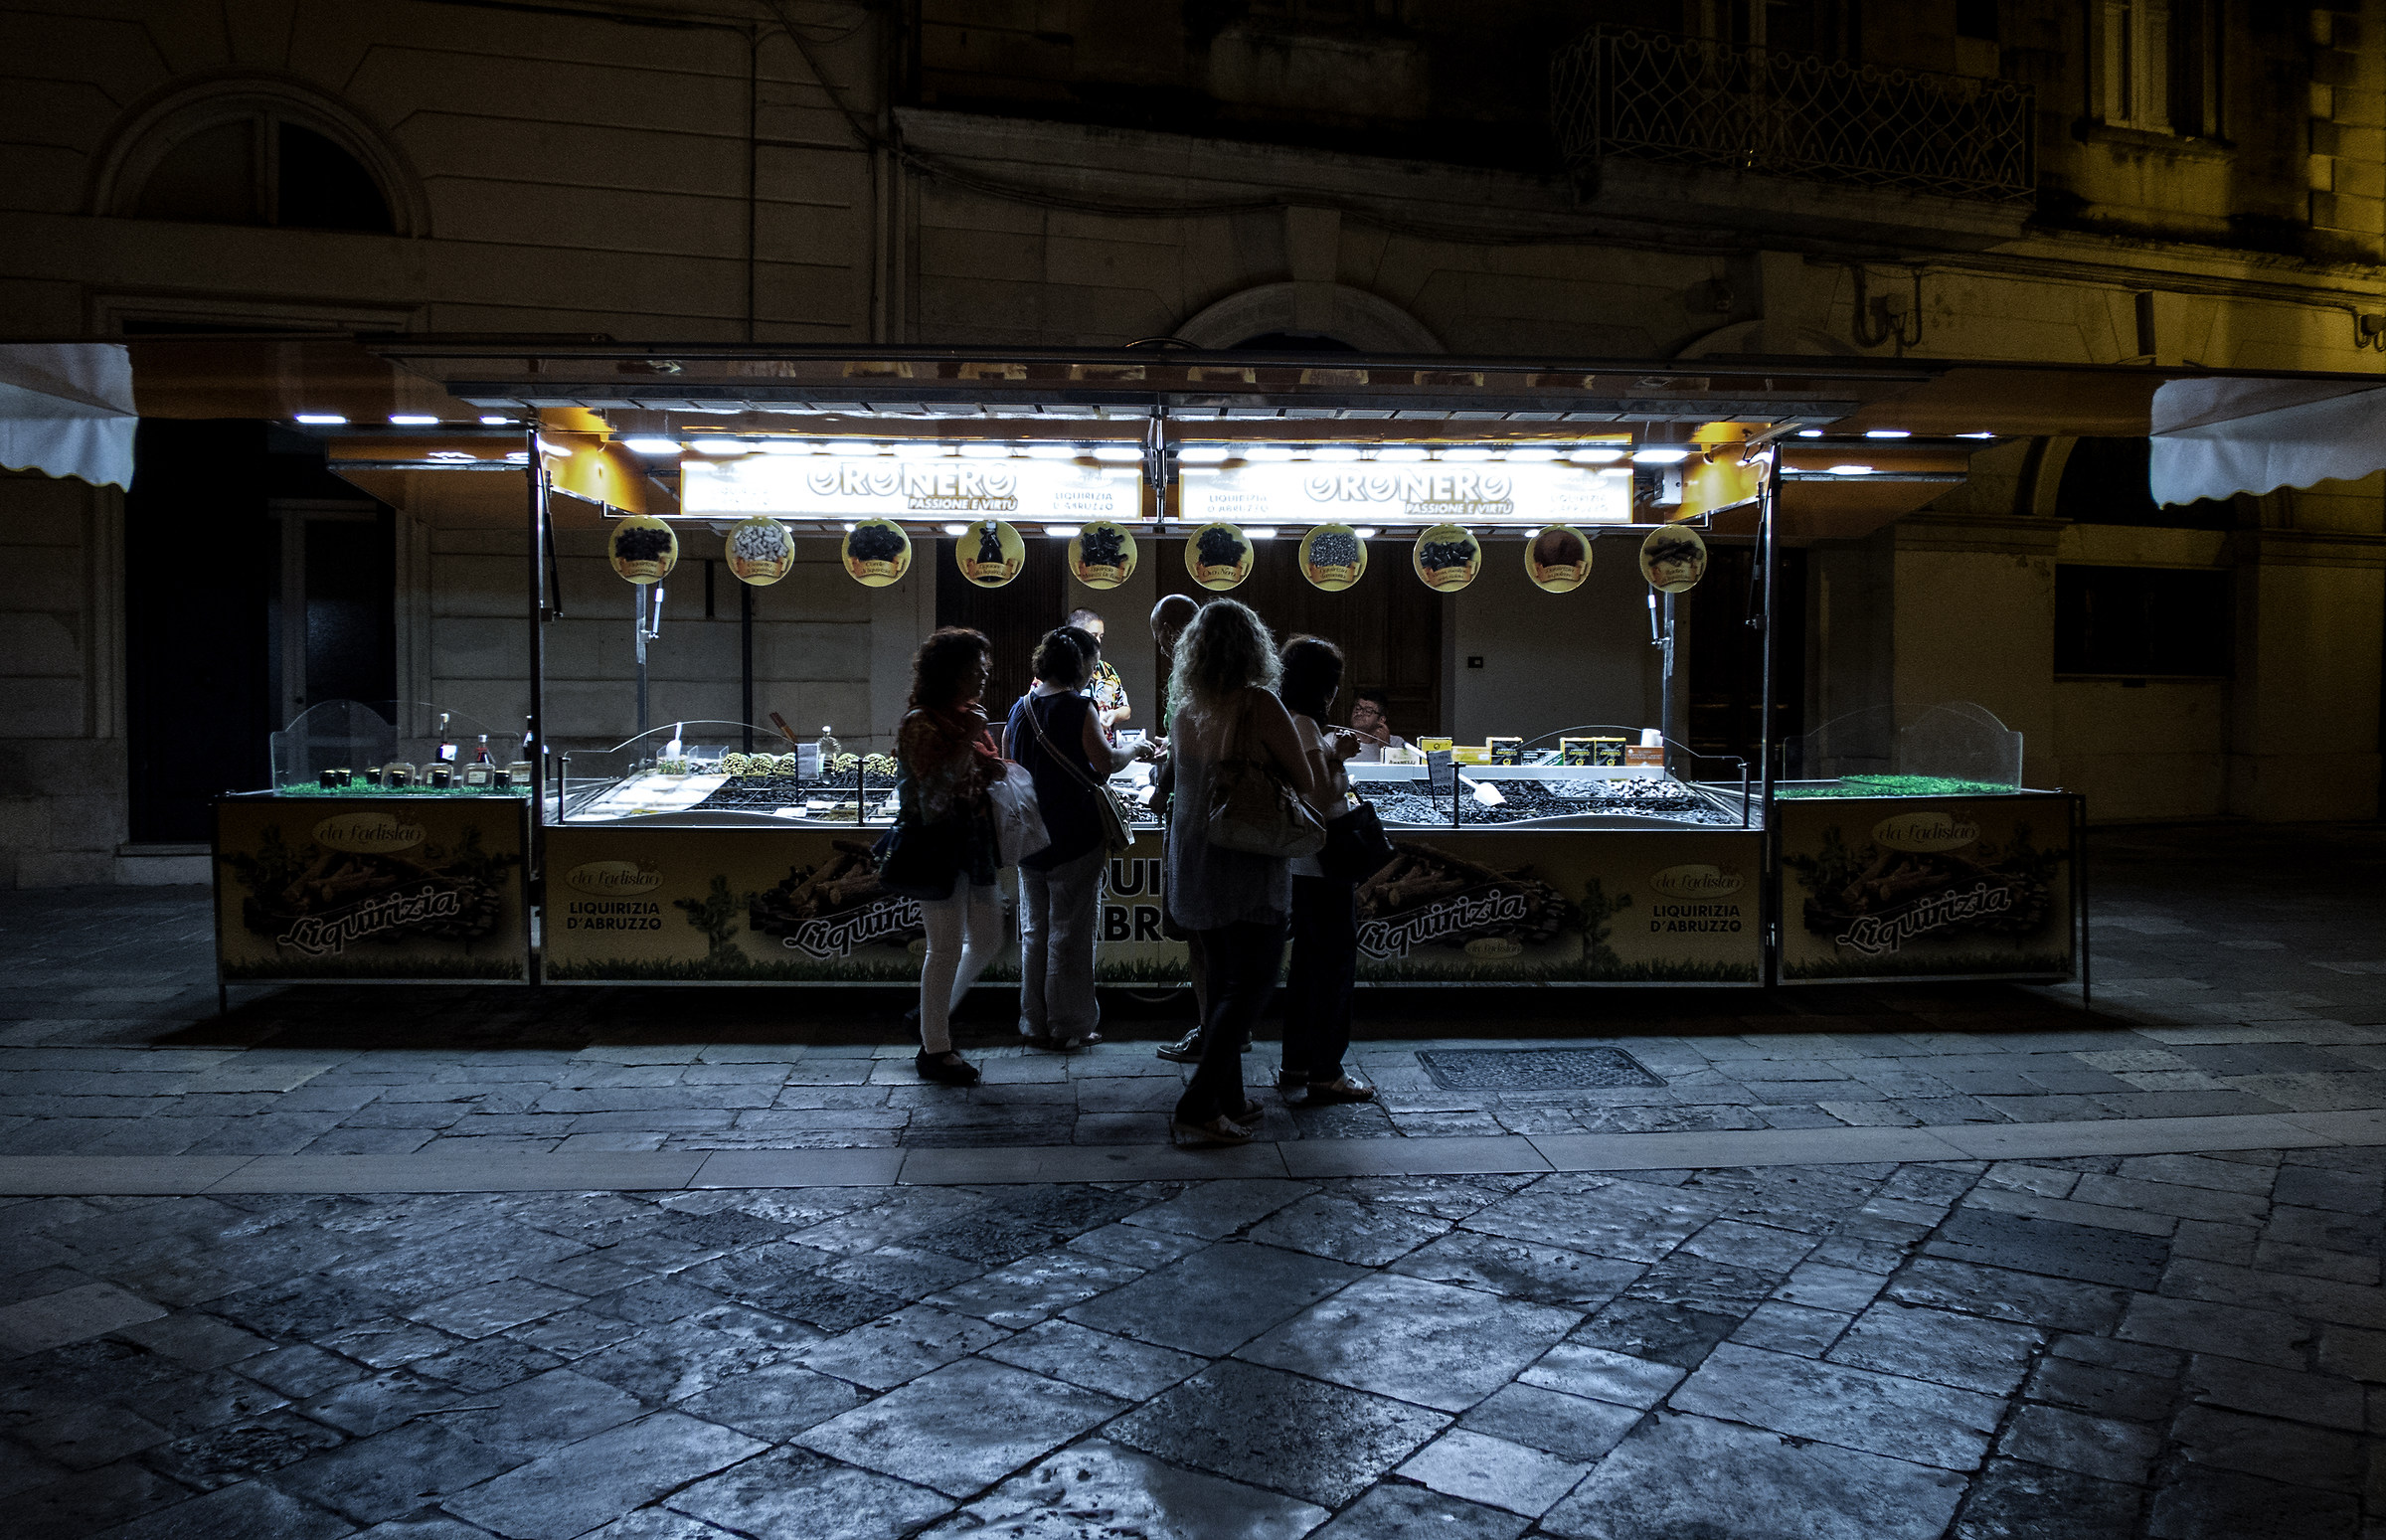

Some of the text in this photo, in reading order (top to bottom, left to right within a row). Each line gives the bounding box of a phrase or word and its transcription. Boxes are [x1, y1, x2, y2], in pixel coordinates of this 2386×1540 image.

[907, 497, 968, 511] PASSIONE
[971, 497, 979, 511] E
[1404, 502, 1464, 515] PASSIONE
[1467, 502, 1475, 515] E
[320, 824, 342, 840] da
[1879, 824, 1901, 840] da
[572, 869, 594, 884] da
[1656, 874, 1676, 889] da
[569, 901, 661, 917] LIQUIRIZIA
[1652, 904, 1741, 919] LIQUIRIZIA
[276, 885, 464, 955] Liquirizia
[567, 915, 662, 931] D'ABRUZZO
[1356, 888, 1529, 962] Liquirizia
[1650, 919, 1743, 934] D'ABRUZZO
[1836, 881, 2013, 956] Liquirizia
